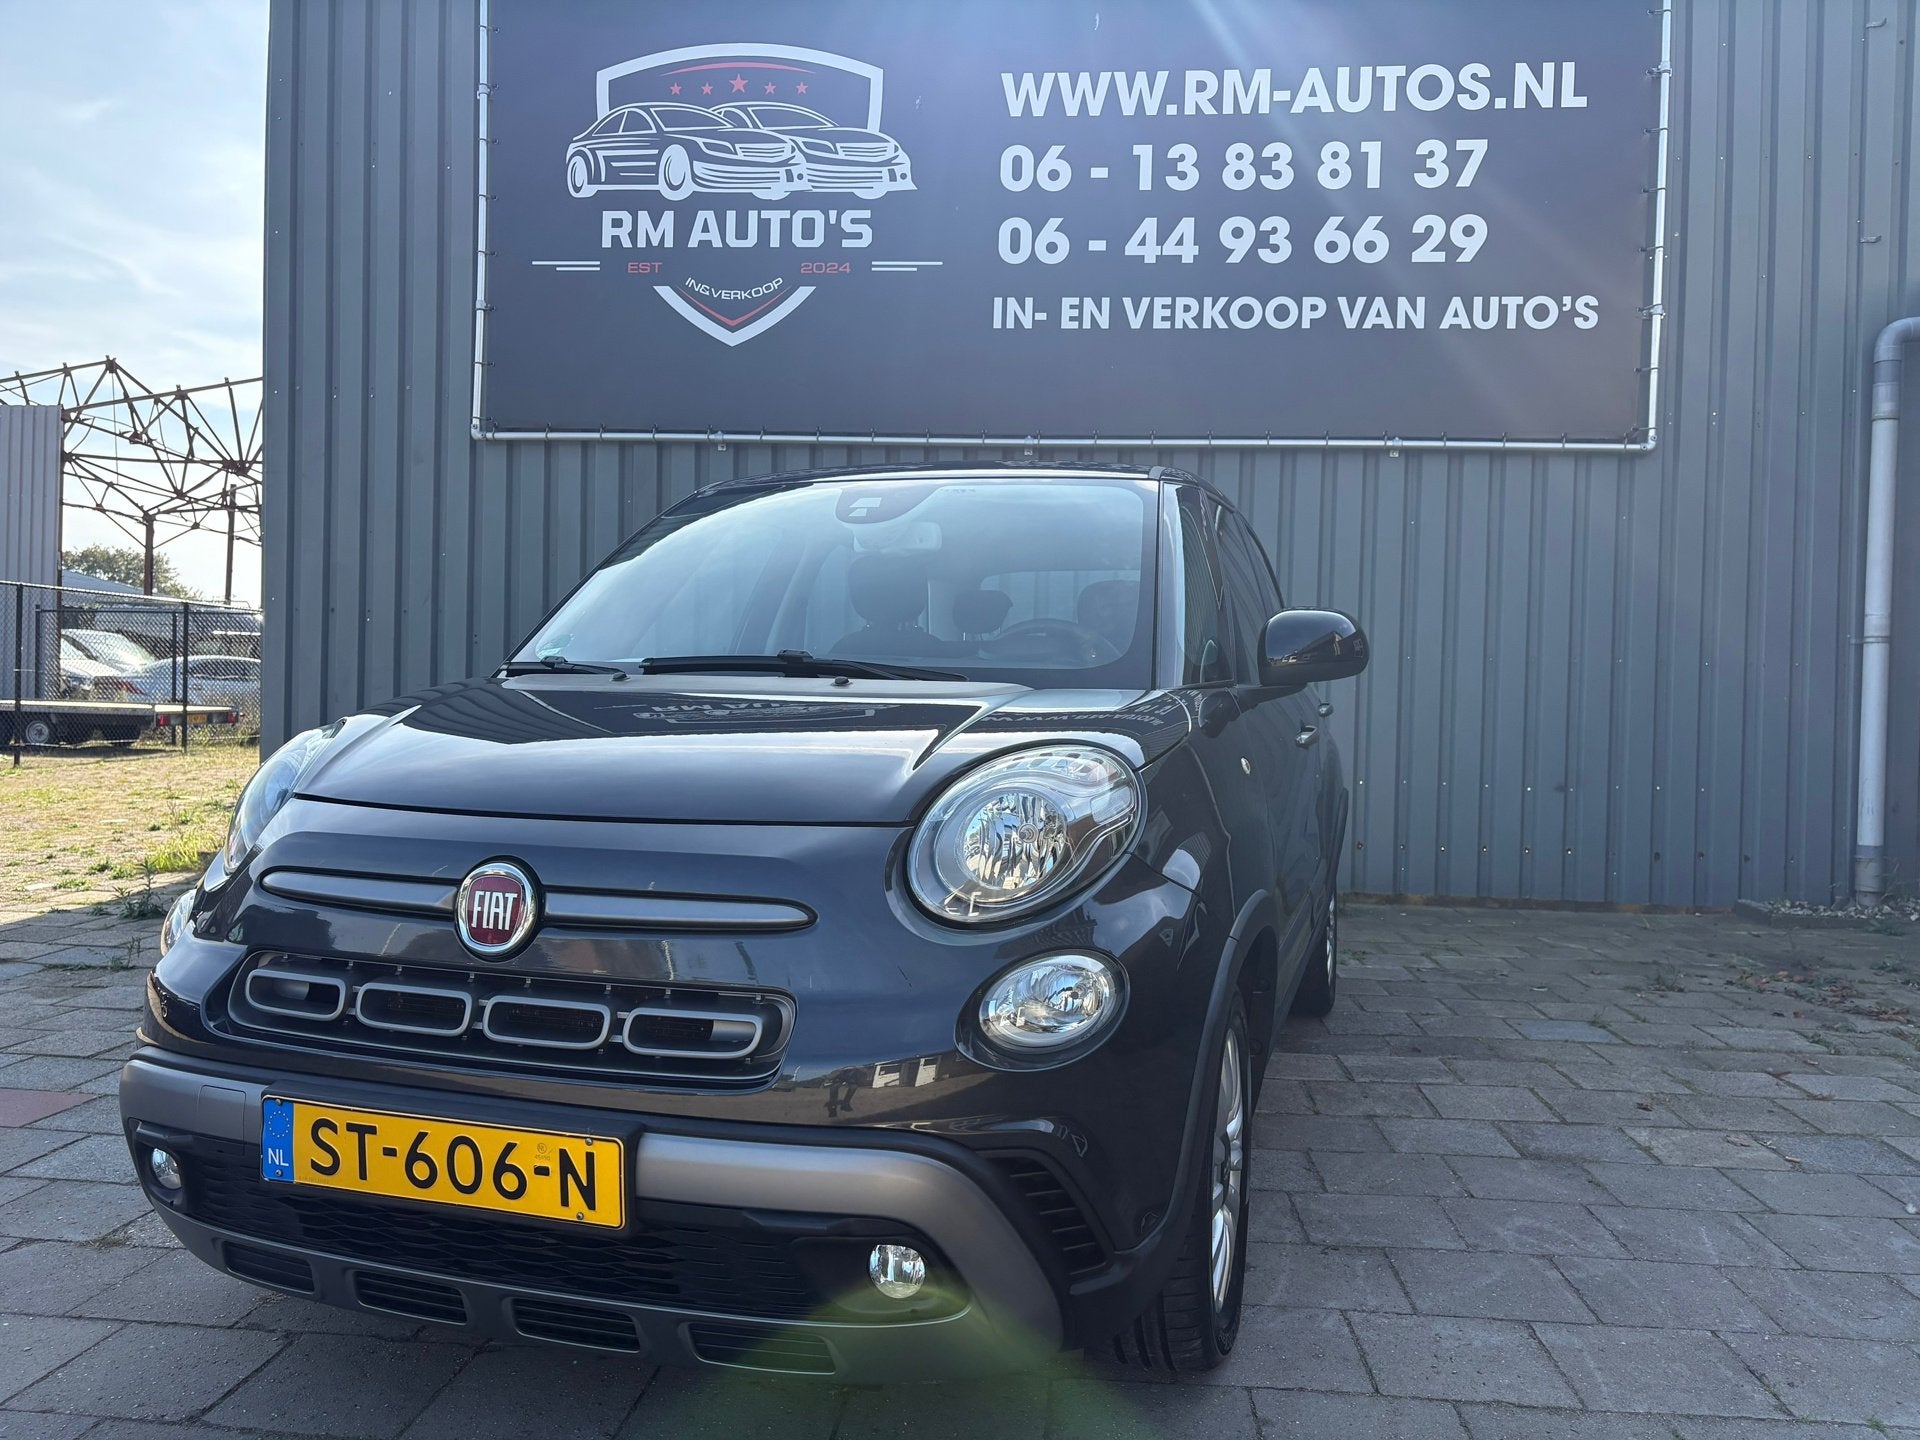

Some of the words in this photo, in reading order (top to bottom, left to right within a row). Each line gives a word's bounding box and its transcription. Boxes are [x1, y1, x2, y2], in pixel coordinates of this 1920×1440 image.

[1001, 61, 1588, 117] WWW.RM-AUTOS.NL
[1000, 144, 1072, 192] 06
[1132, 143, 1200, 191] 13
[1221, 142, 1295, 191] 83
[1316, 140, 1382, 190] 81
[1413, 138, 1489, 189] 37
[601, 210, 675, 248] RM
[687, 209, 873, 248] AUTO'S
[998, 216, 1070, 265] 06
[1124, 216, 1200, 264] 44
[1219, 215, 1293, 264] 93
[1313, 215, 1390, 264] 66
[1411, 213, 1488, 263] 29
[627, 262, 663, 273] EST
[800, 262, 852, 273] 2024
[685, 277, 784, 300] IN&VERKOOP
[992, 296, 1047, 329] IN-
[1060, 296, 1111, 330] EN
[1122, 295, 1327, 330] VERKOOP
[1337, 296, 1426, 329] VAN
[1438, 294, 1599, 330] AUTO'S
[471, 890, 518, 931] FIAT
[267, 1147, 290, 1167] NL
[310, 1117, 596, 1212] ST-606-N
